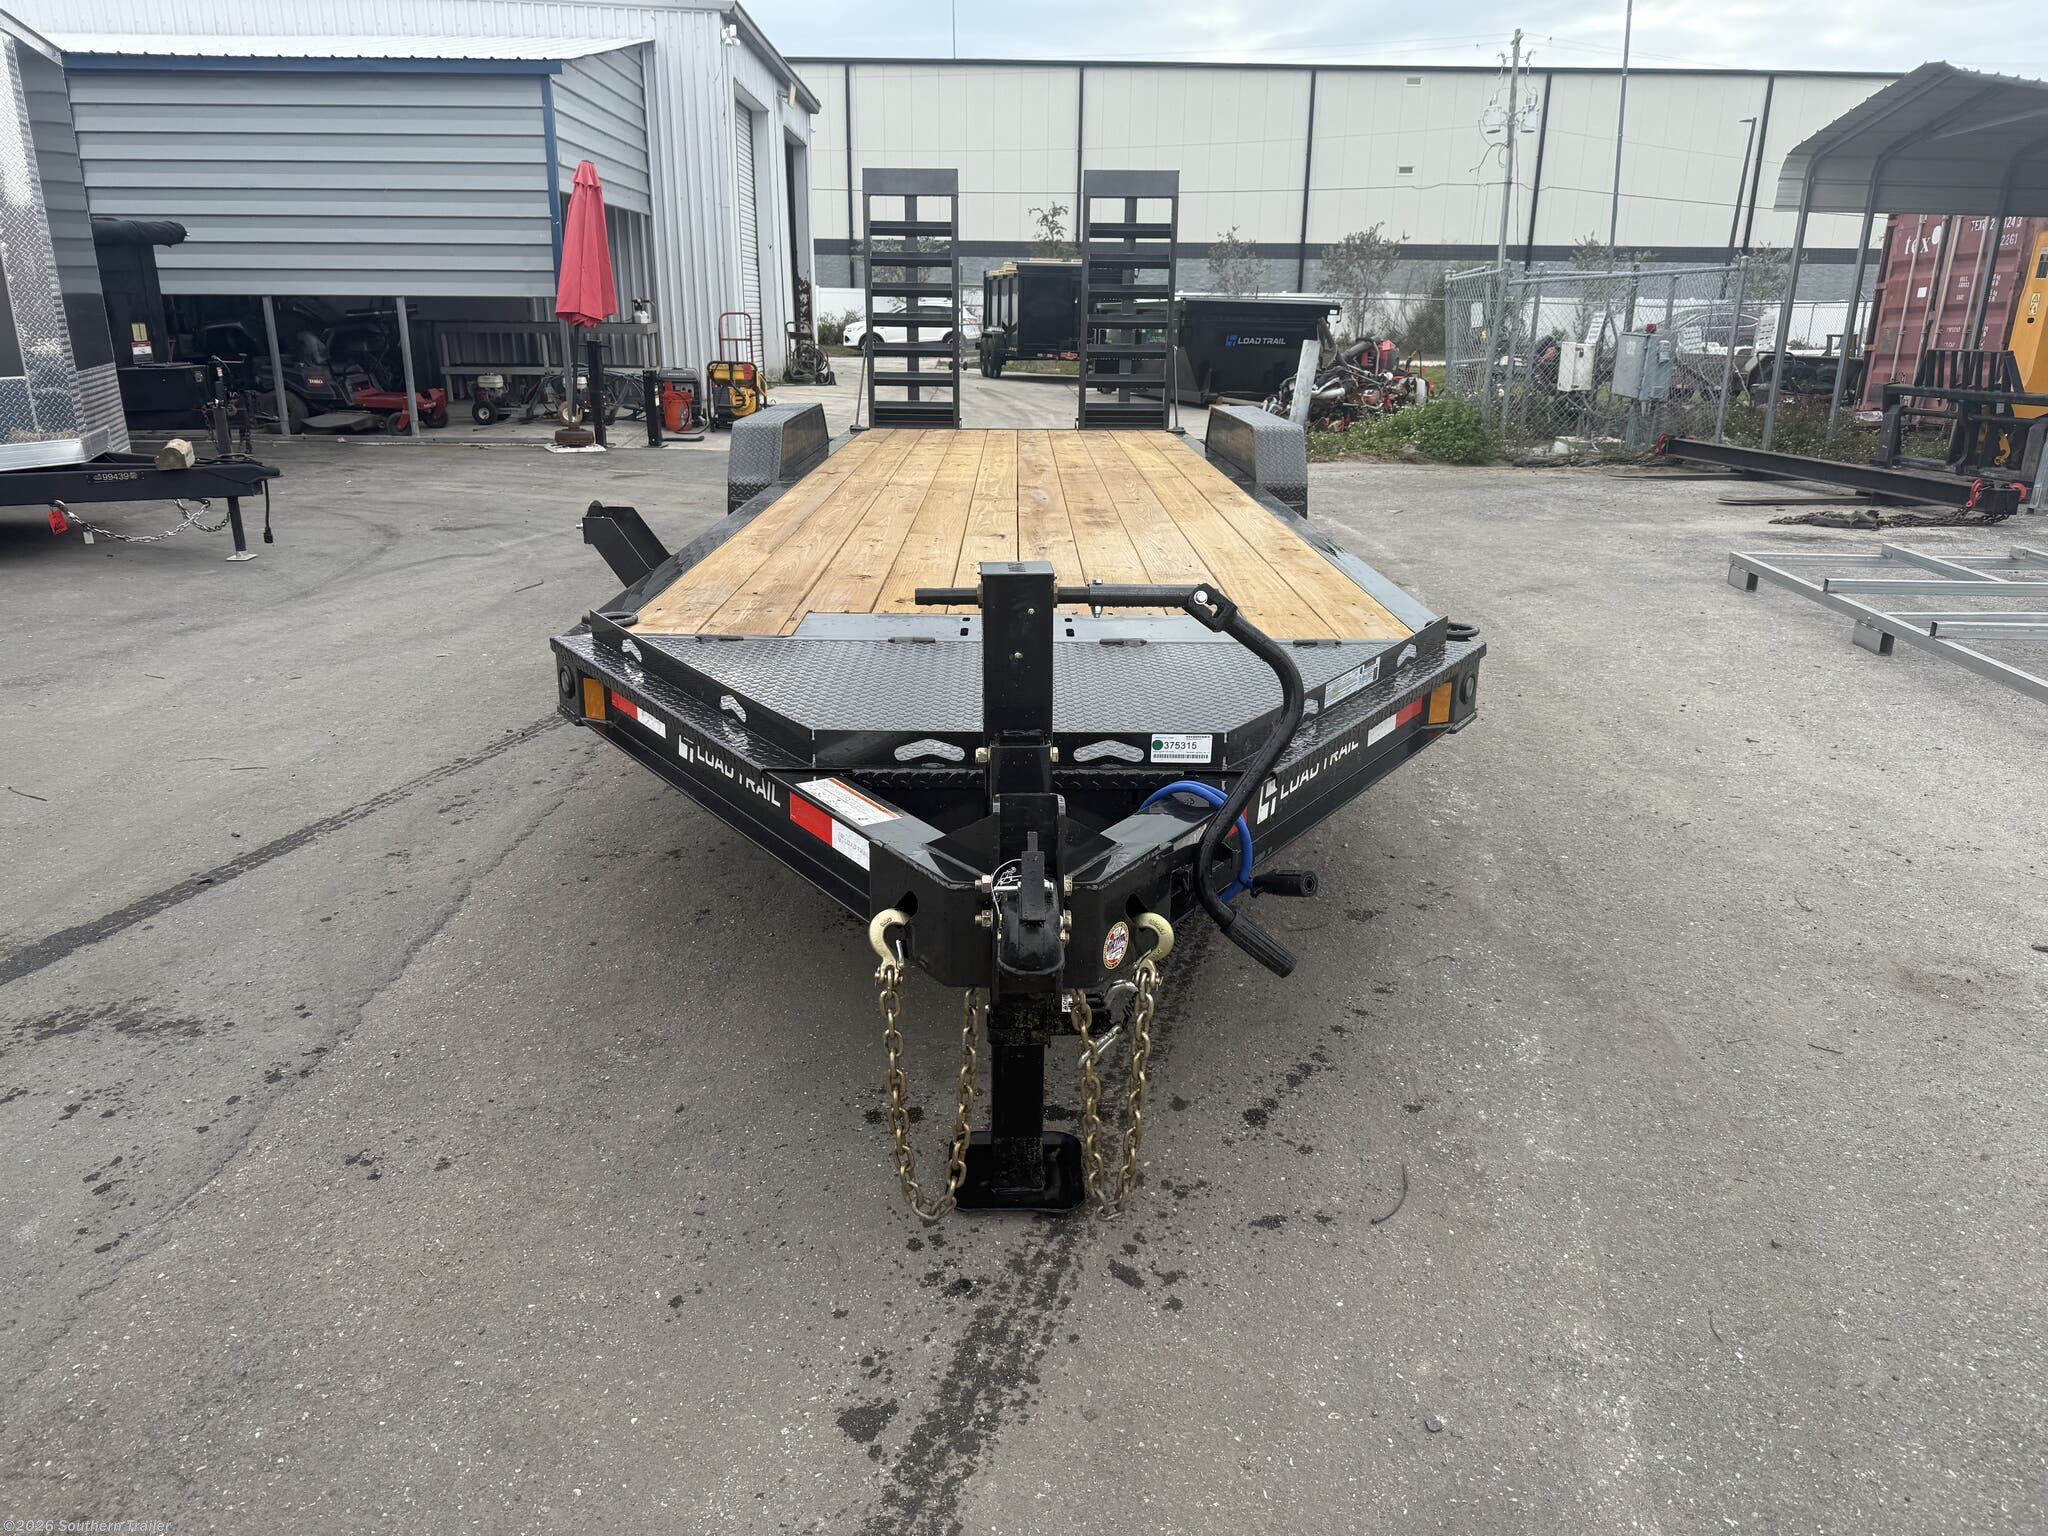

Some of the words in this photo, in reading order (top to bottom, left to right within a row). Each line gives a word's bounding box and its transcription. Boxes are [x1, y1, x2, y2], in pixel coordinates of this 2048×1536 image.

[1237, 337, 1261, 345] LOAD
[1262, 337, 1286, 345] TRAIL
[1163, 741, 1197, 750] 375315
[697, 745, 734, 779] LOAD
[738, 773, 781, 808] TRAIL
[1280, 762, 1320, 800] LOAD
